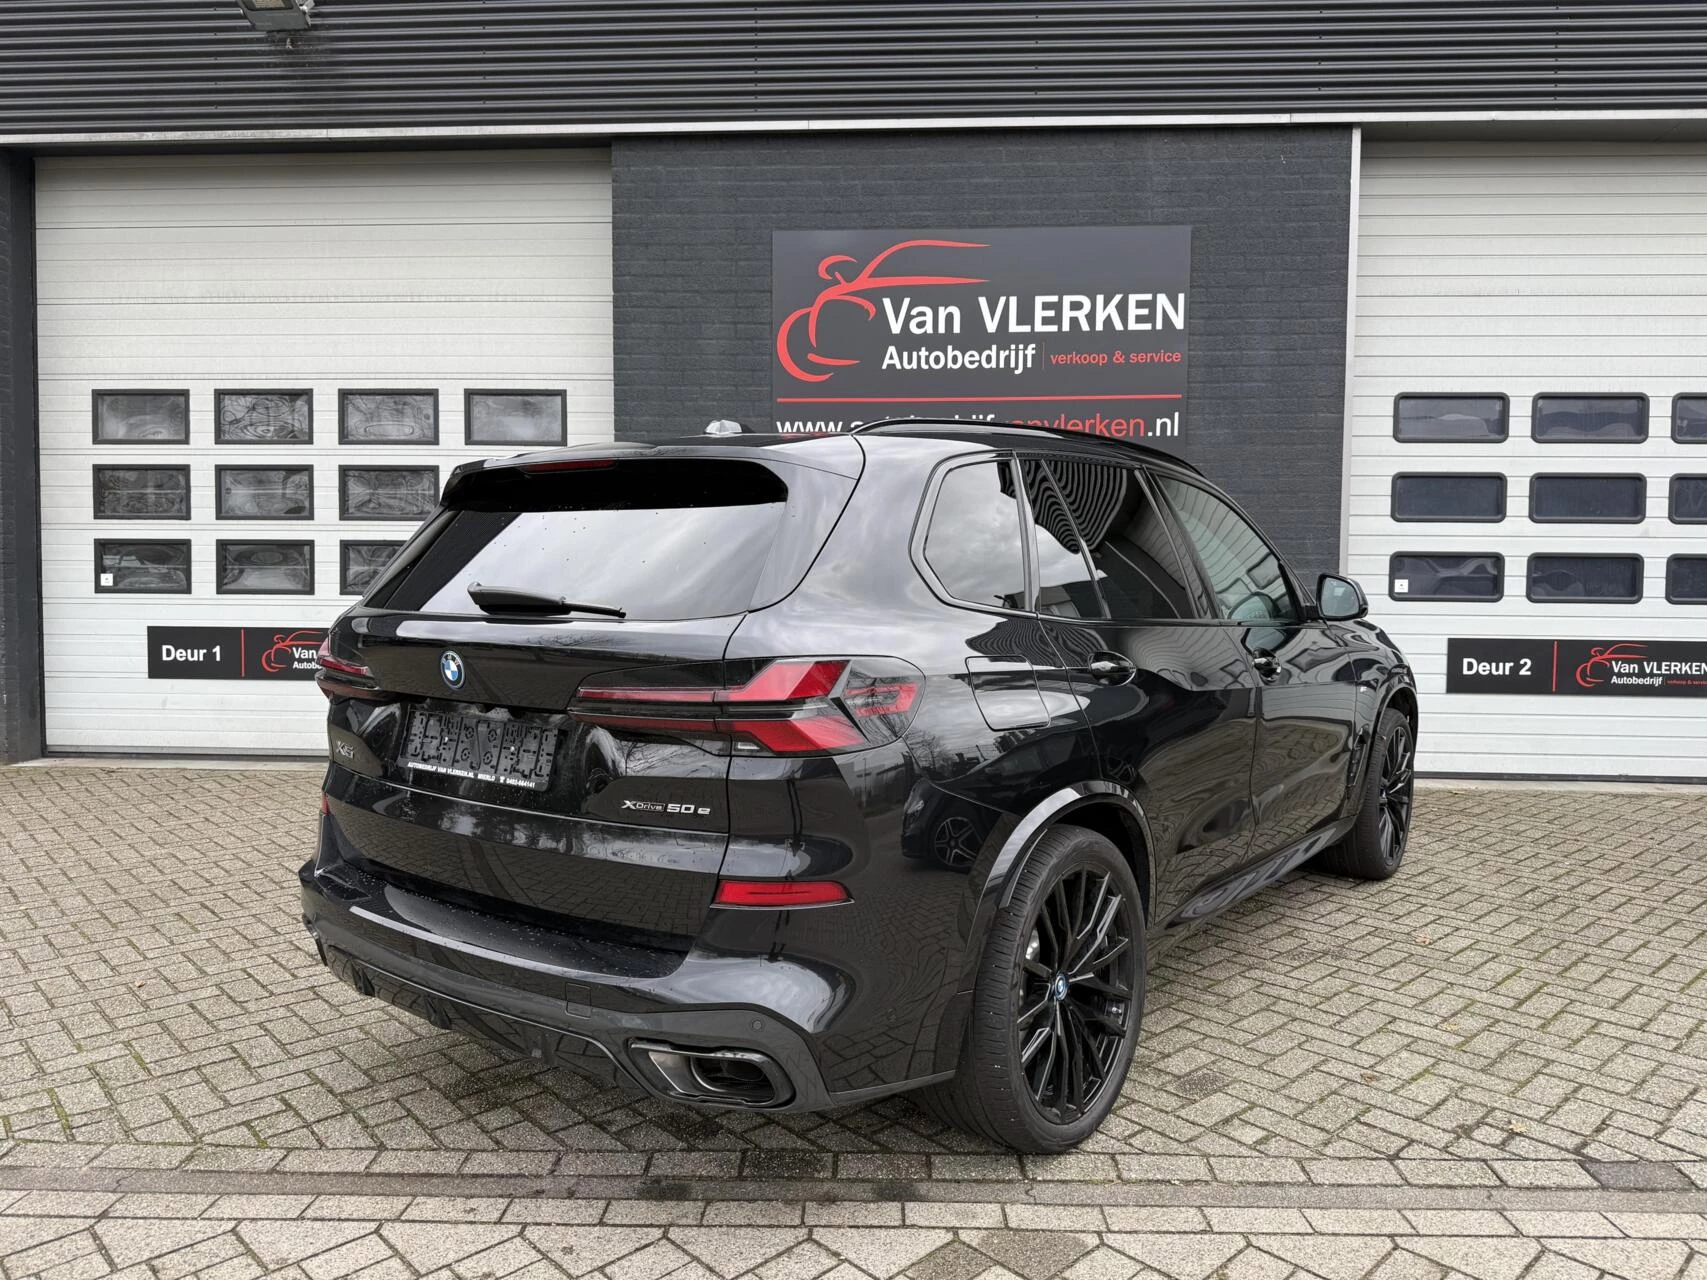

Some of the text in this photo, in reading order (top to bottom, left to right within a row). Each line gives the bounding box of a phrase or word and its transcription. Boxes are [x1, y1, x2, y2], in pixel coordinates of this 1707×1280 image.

[882, 293, 1185, 335] Van VLERKEN
[881, 343, 1036, 375] Autobedrijf
[1050, 349, 1182, 366] verkoop & service
[162, 645, 221, 661] Deur 1
[292, 646, 317, 659] Van
[1462, 658, 1532, 676] Deur 2
[1611, 660, 1638, 674] Van
[1610, 675, 1663, 687] Autobedrijf
[666, 803, 696, 813] 50
[697, 807, 711, 815] e
